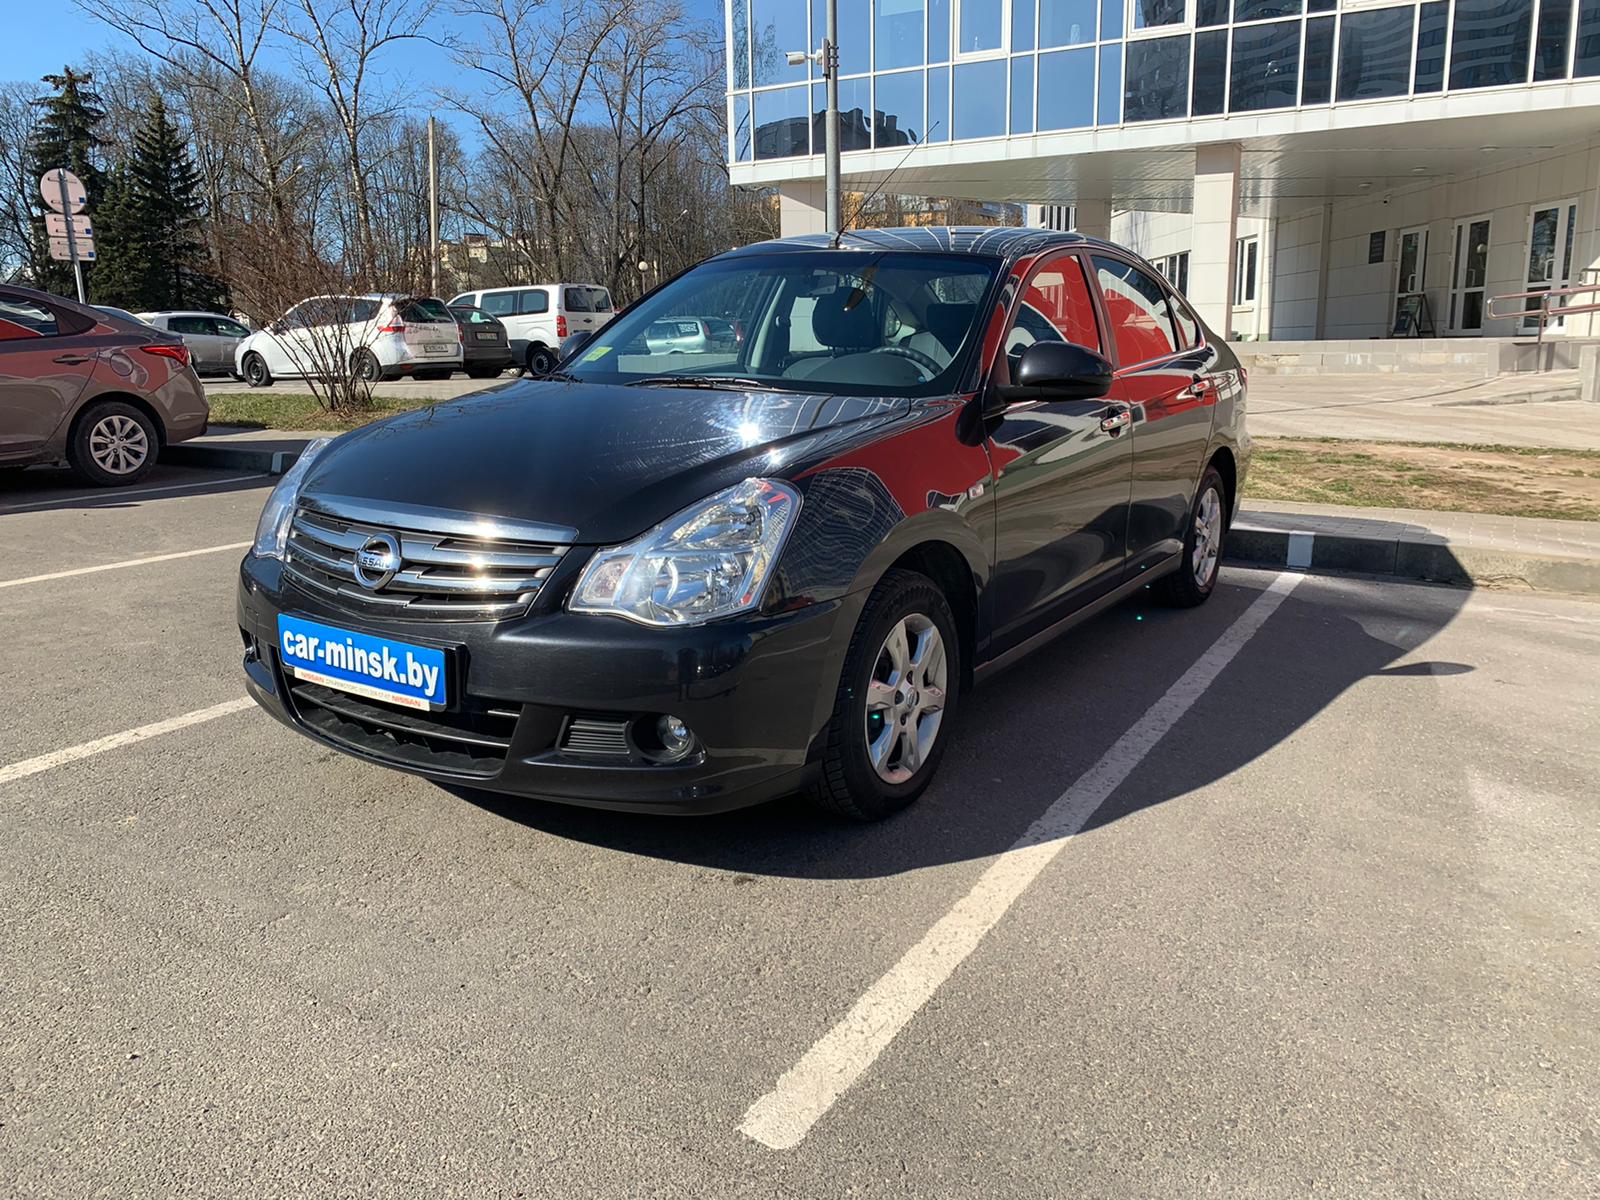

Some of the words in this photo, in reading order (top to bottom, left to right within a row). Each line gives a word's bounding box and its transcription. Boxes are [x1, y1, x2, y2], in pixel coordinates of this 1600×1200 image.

[357, 555, 391, 569] SSAN
[283, 630, 439, 697] car-minsk.by
[391, 694, 422, 707] NISSAN
